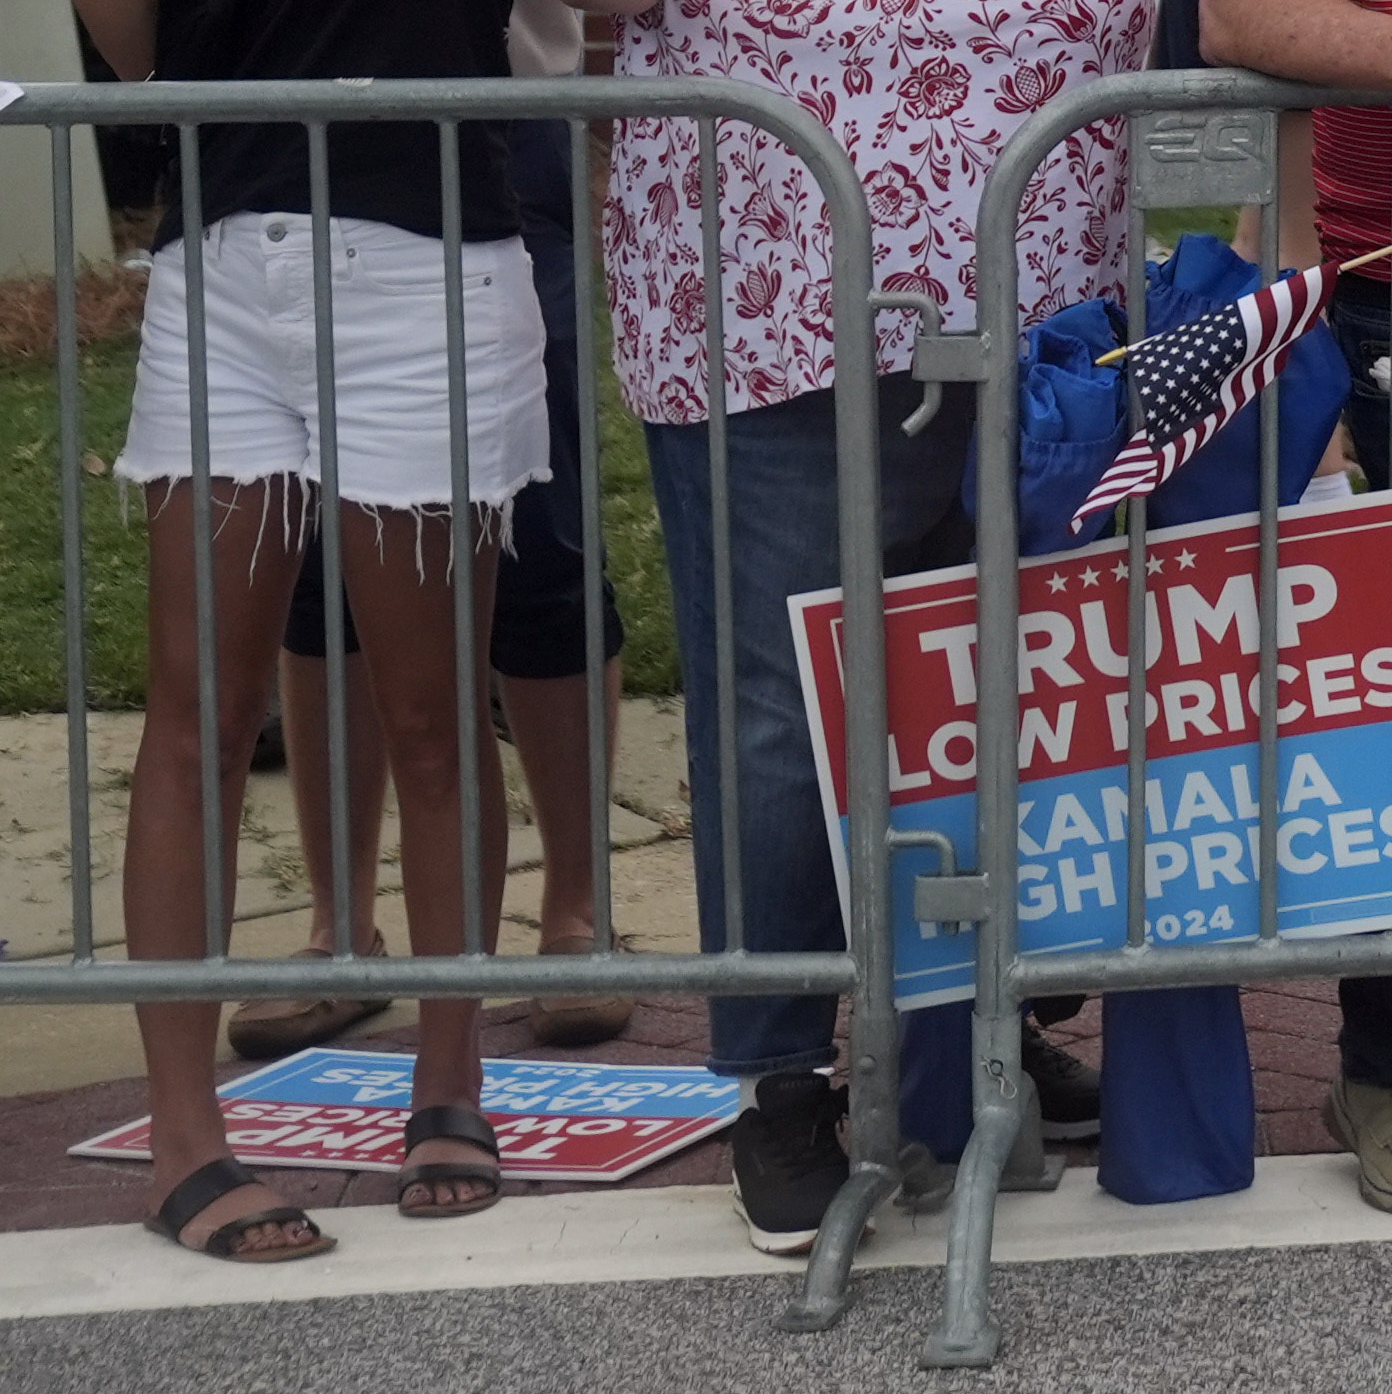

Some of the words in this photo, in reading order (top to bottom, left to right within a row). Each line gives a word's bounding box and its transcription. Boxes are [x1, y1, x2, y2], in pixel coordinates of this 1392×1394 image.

[918, 564, 1338, 706] TRUMP
[888, 700, 1078, 792] LOW
[1017, 753, 1343, 856] KAMALA
[353, 1086, 645, 1113] KAMA
[560, 1081, 740, 1099] HIGH
[223, 1102, 412, 1129] RICES
[494, 1116, 674, 1136] LOW
